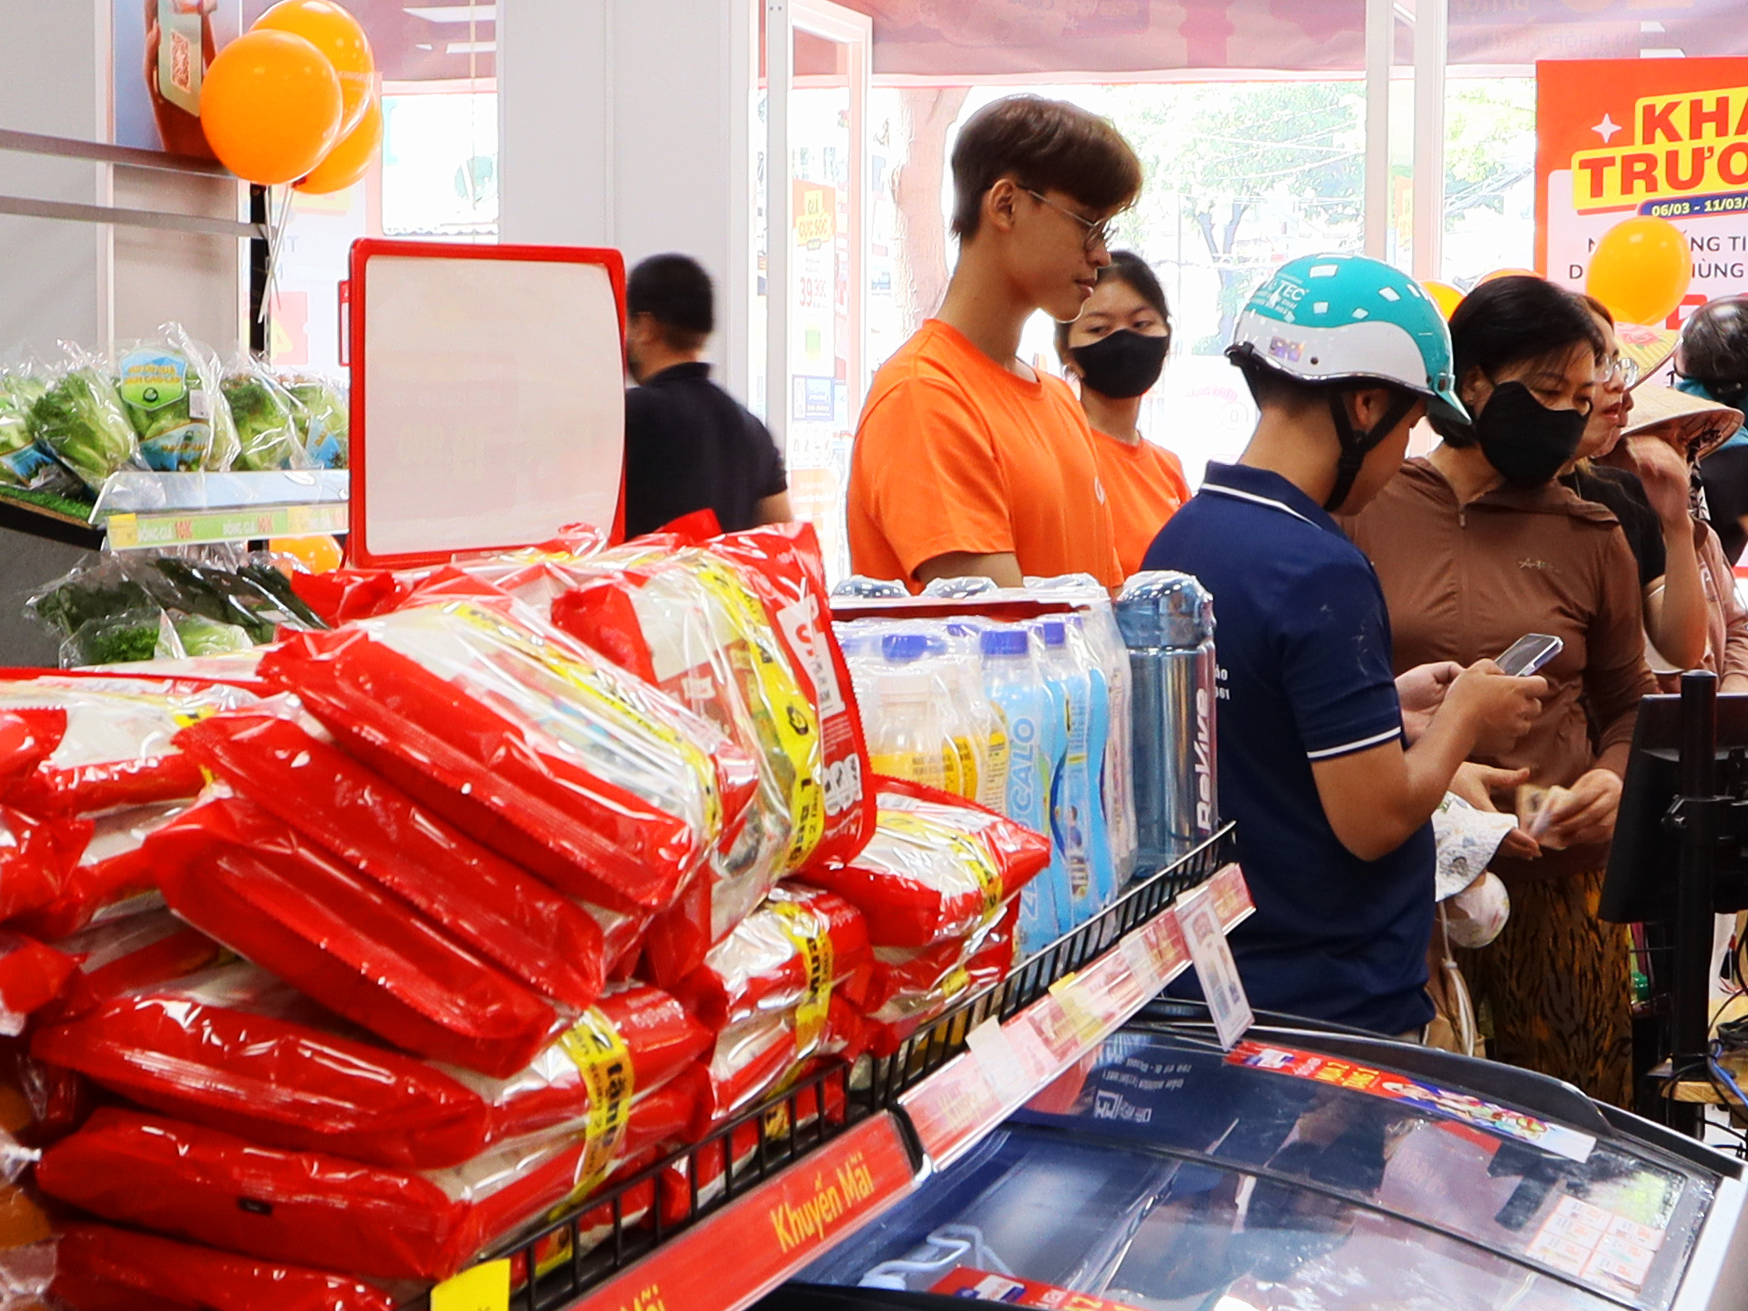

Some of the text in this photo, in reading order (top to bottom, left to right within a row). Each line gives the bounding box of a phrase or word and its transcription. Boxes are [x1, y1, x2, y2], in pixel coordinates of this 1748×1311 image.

[1651, 199, 1692, 218] 06/03
[769, 1151, 876, 1253] Khuyến Mãi
